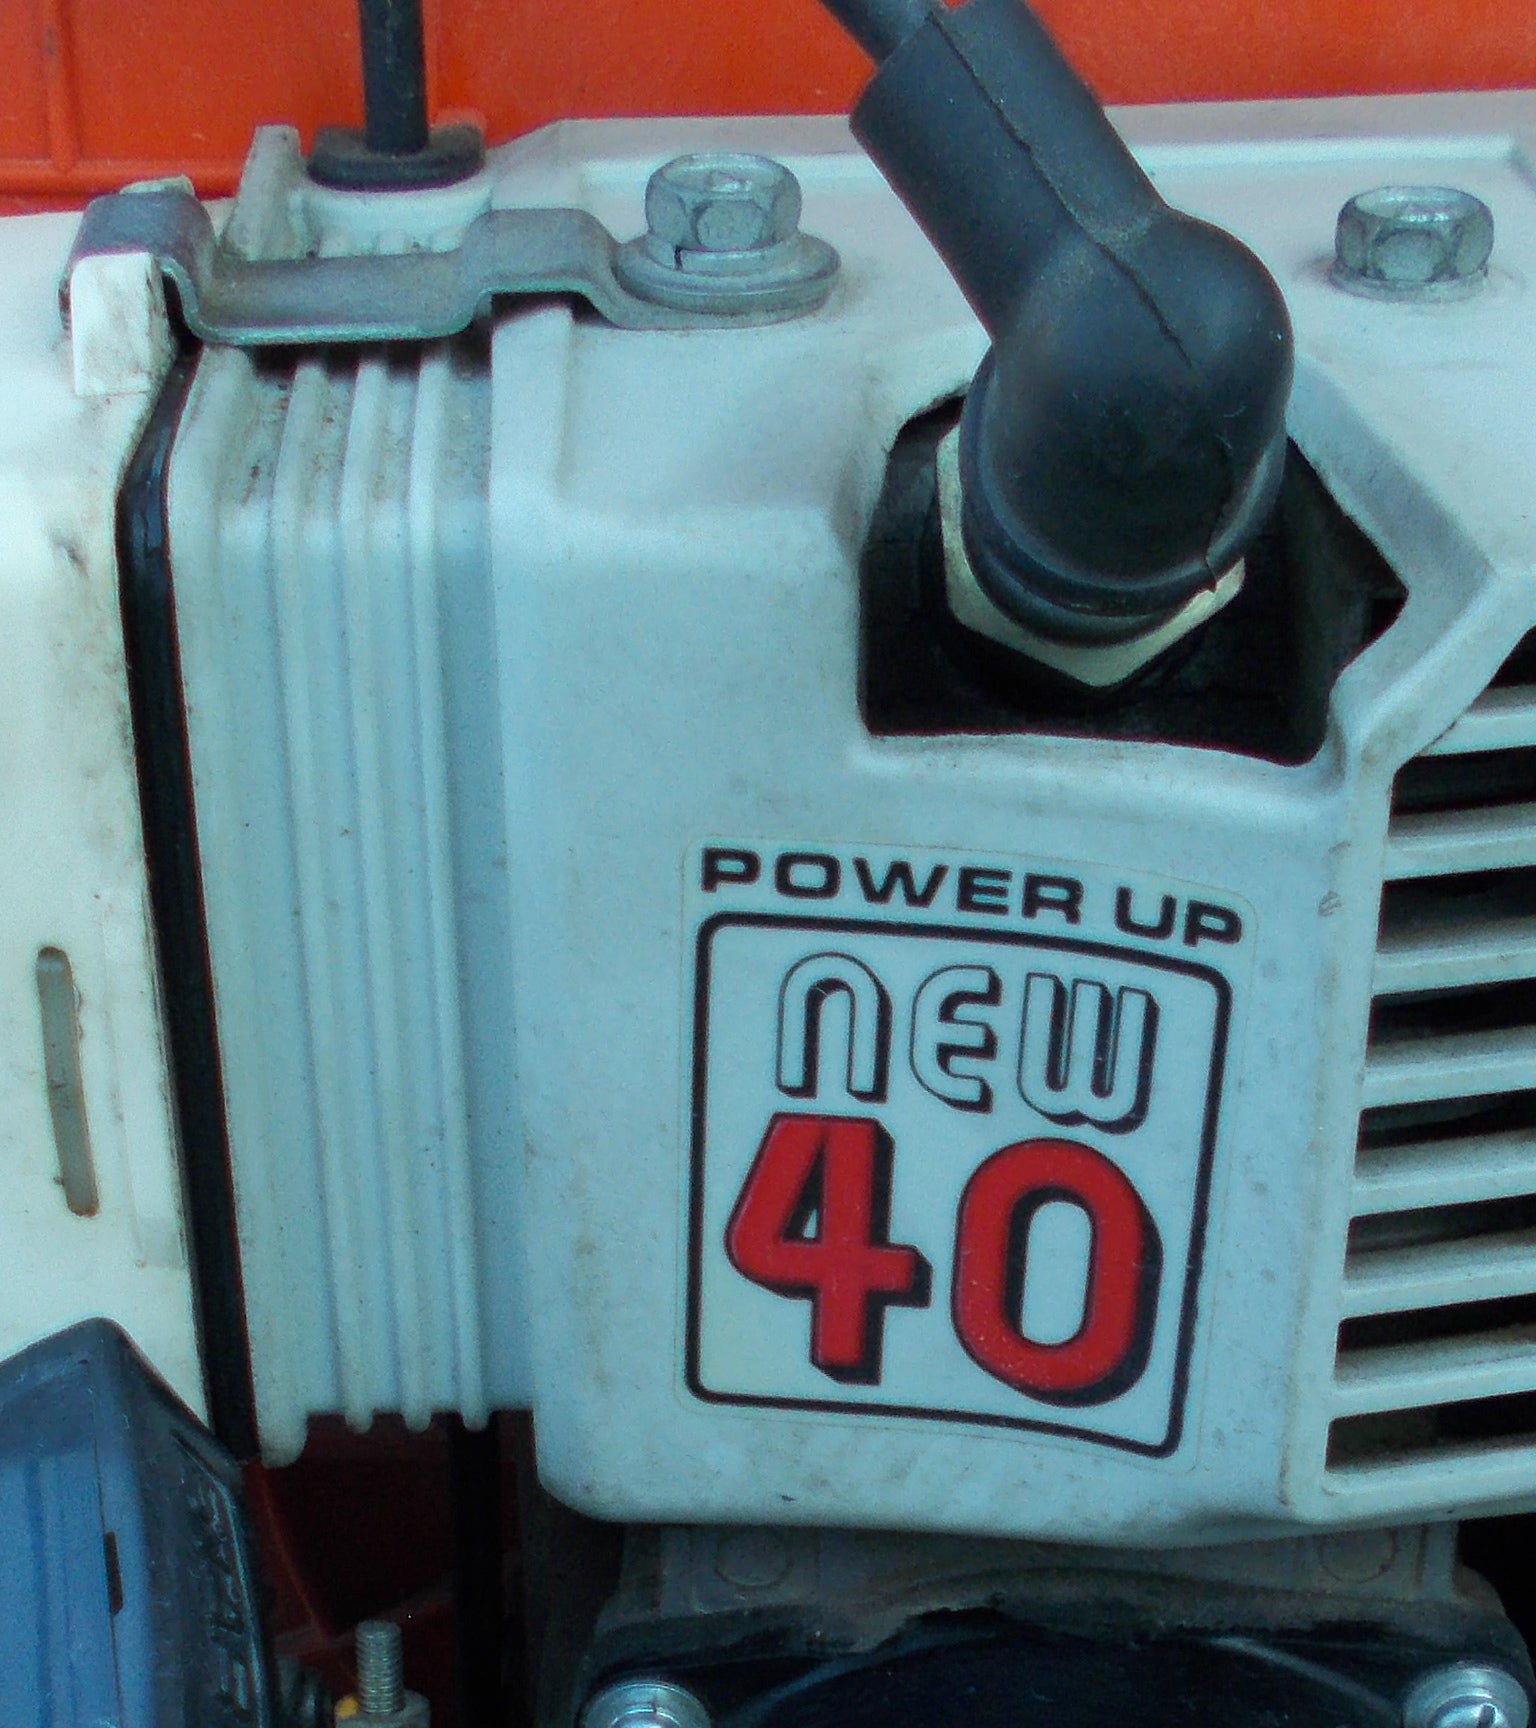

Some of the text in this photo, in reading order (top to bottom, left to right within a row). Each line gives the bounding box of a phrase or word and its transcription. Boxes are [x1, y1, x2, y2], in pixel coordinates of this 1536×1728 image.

[700, 846, 1243, 948] POWER UP
[723, 1111, 1164, 1408] 40
